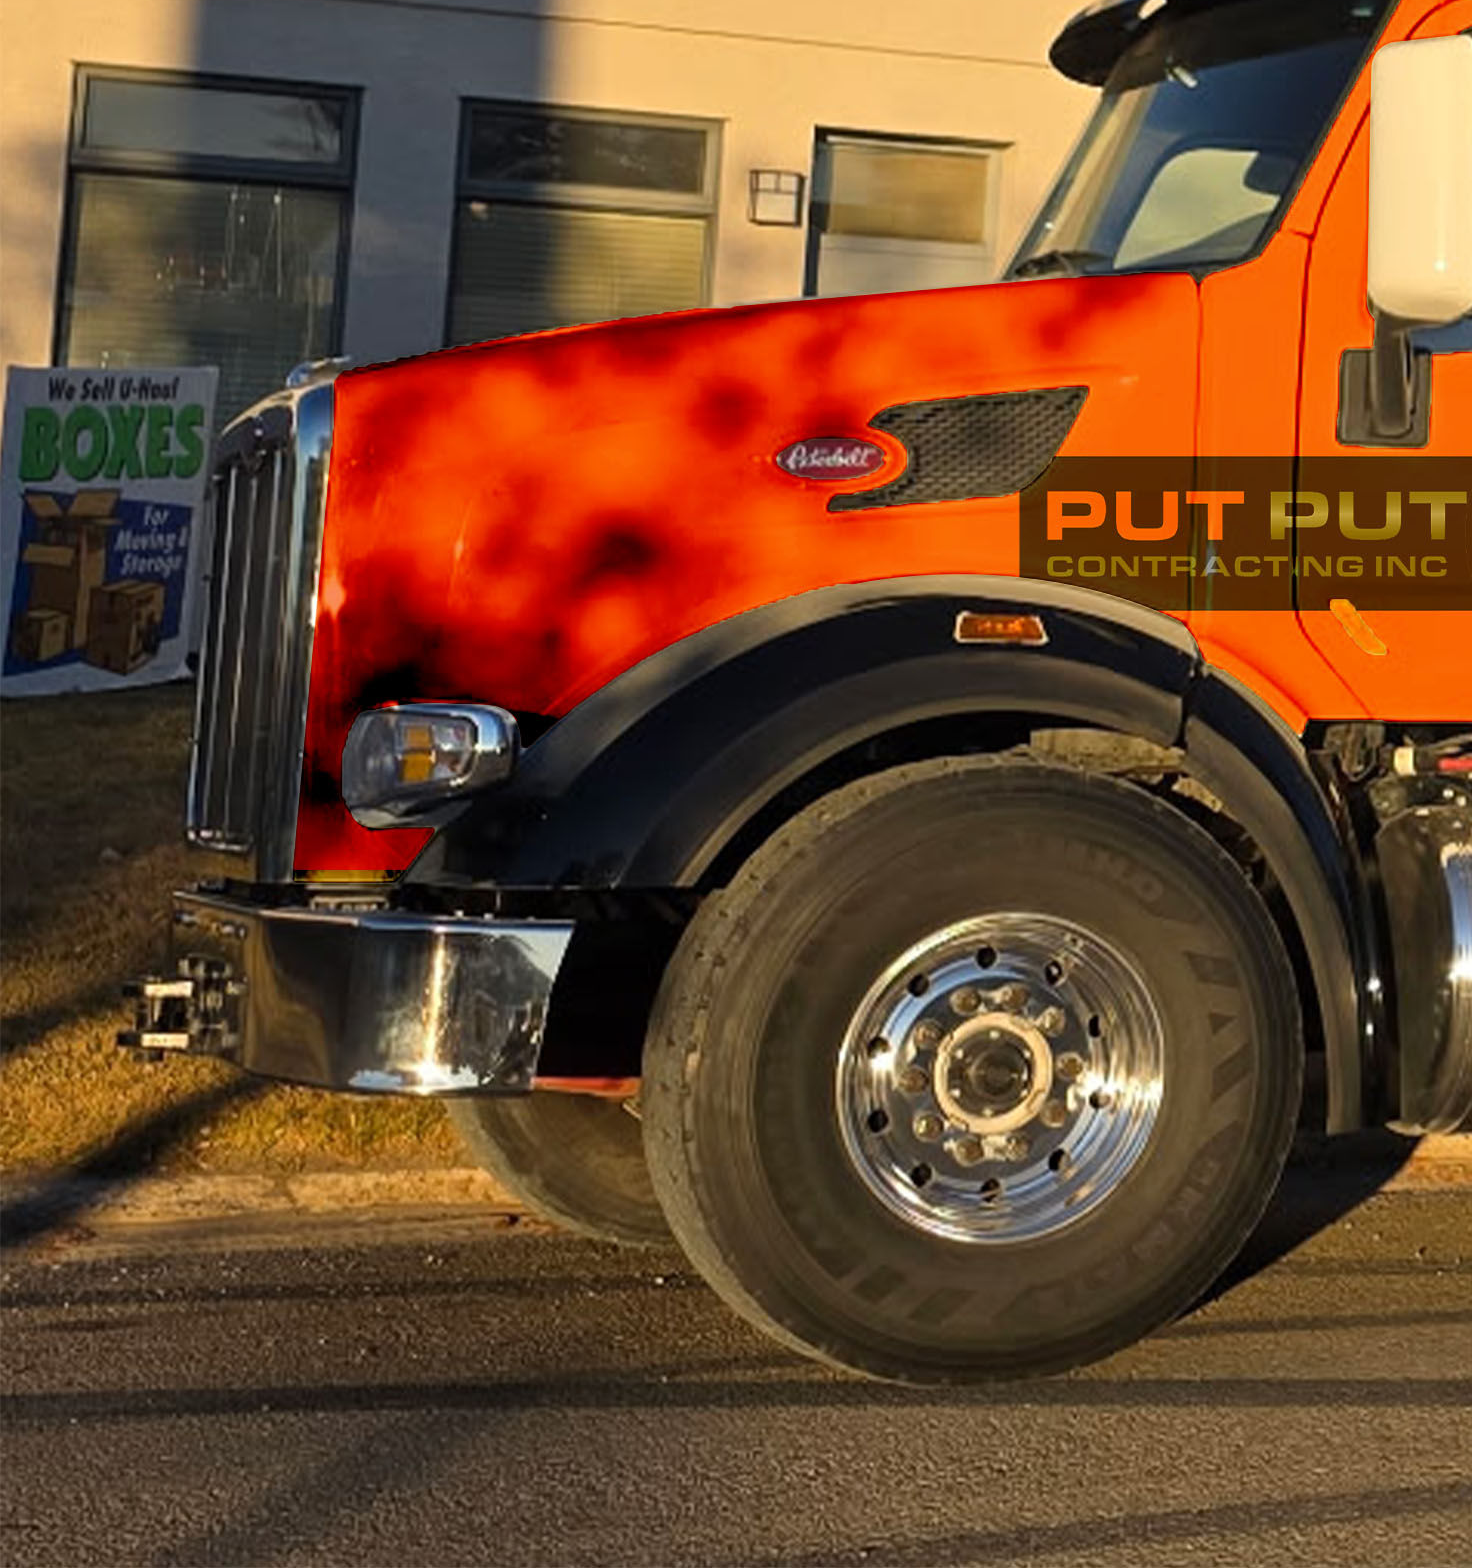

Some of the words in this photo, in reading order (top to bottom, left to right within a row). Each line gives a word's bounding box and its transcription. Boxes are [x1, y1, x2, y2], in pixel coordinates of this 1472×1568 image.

[48, 377, 76, 402] We
[80, 377, 115, 402] Sell
[18, 402, 205, 483] BOXES
[1046, 490, 1245, 541] PUT
[1269, 490, 1468, 541] PUT
[114, 527, 176, 555] Moving
[1046, 554, 1364, 578] CONTRACTING
[1375, 554, 1448, 578] INC
